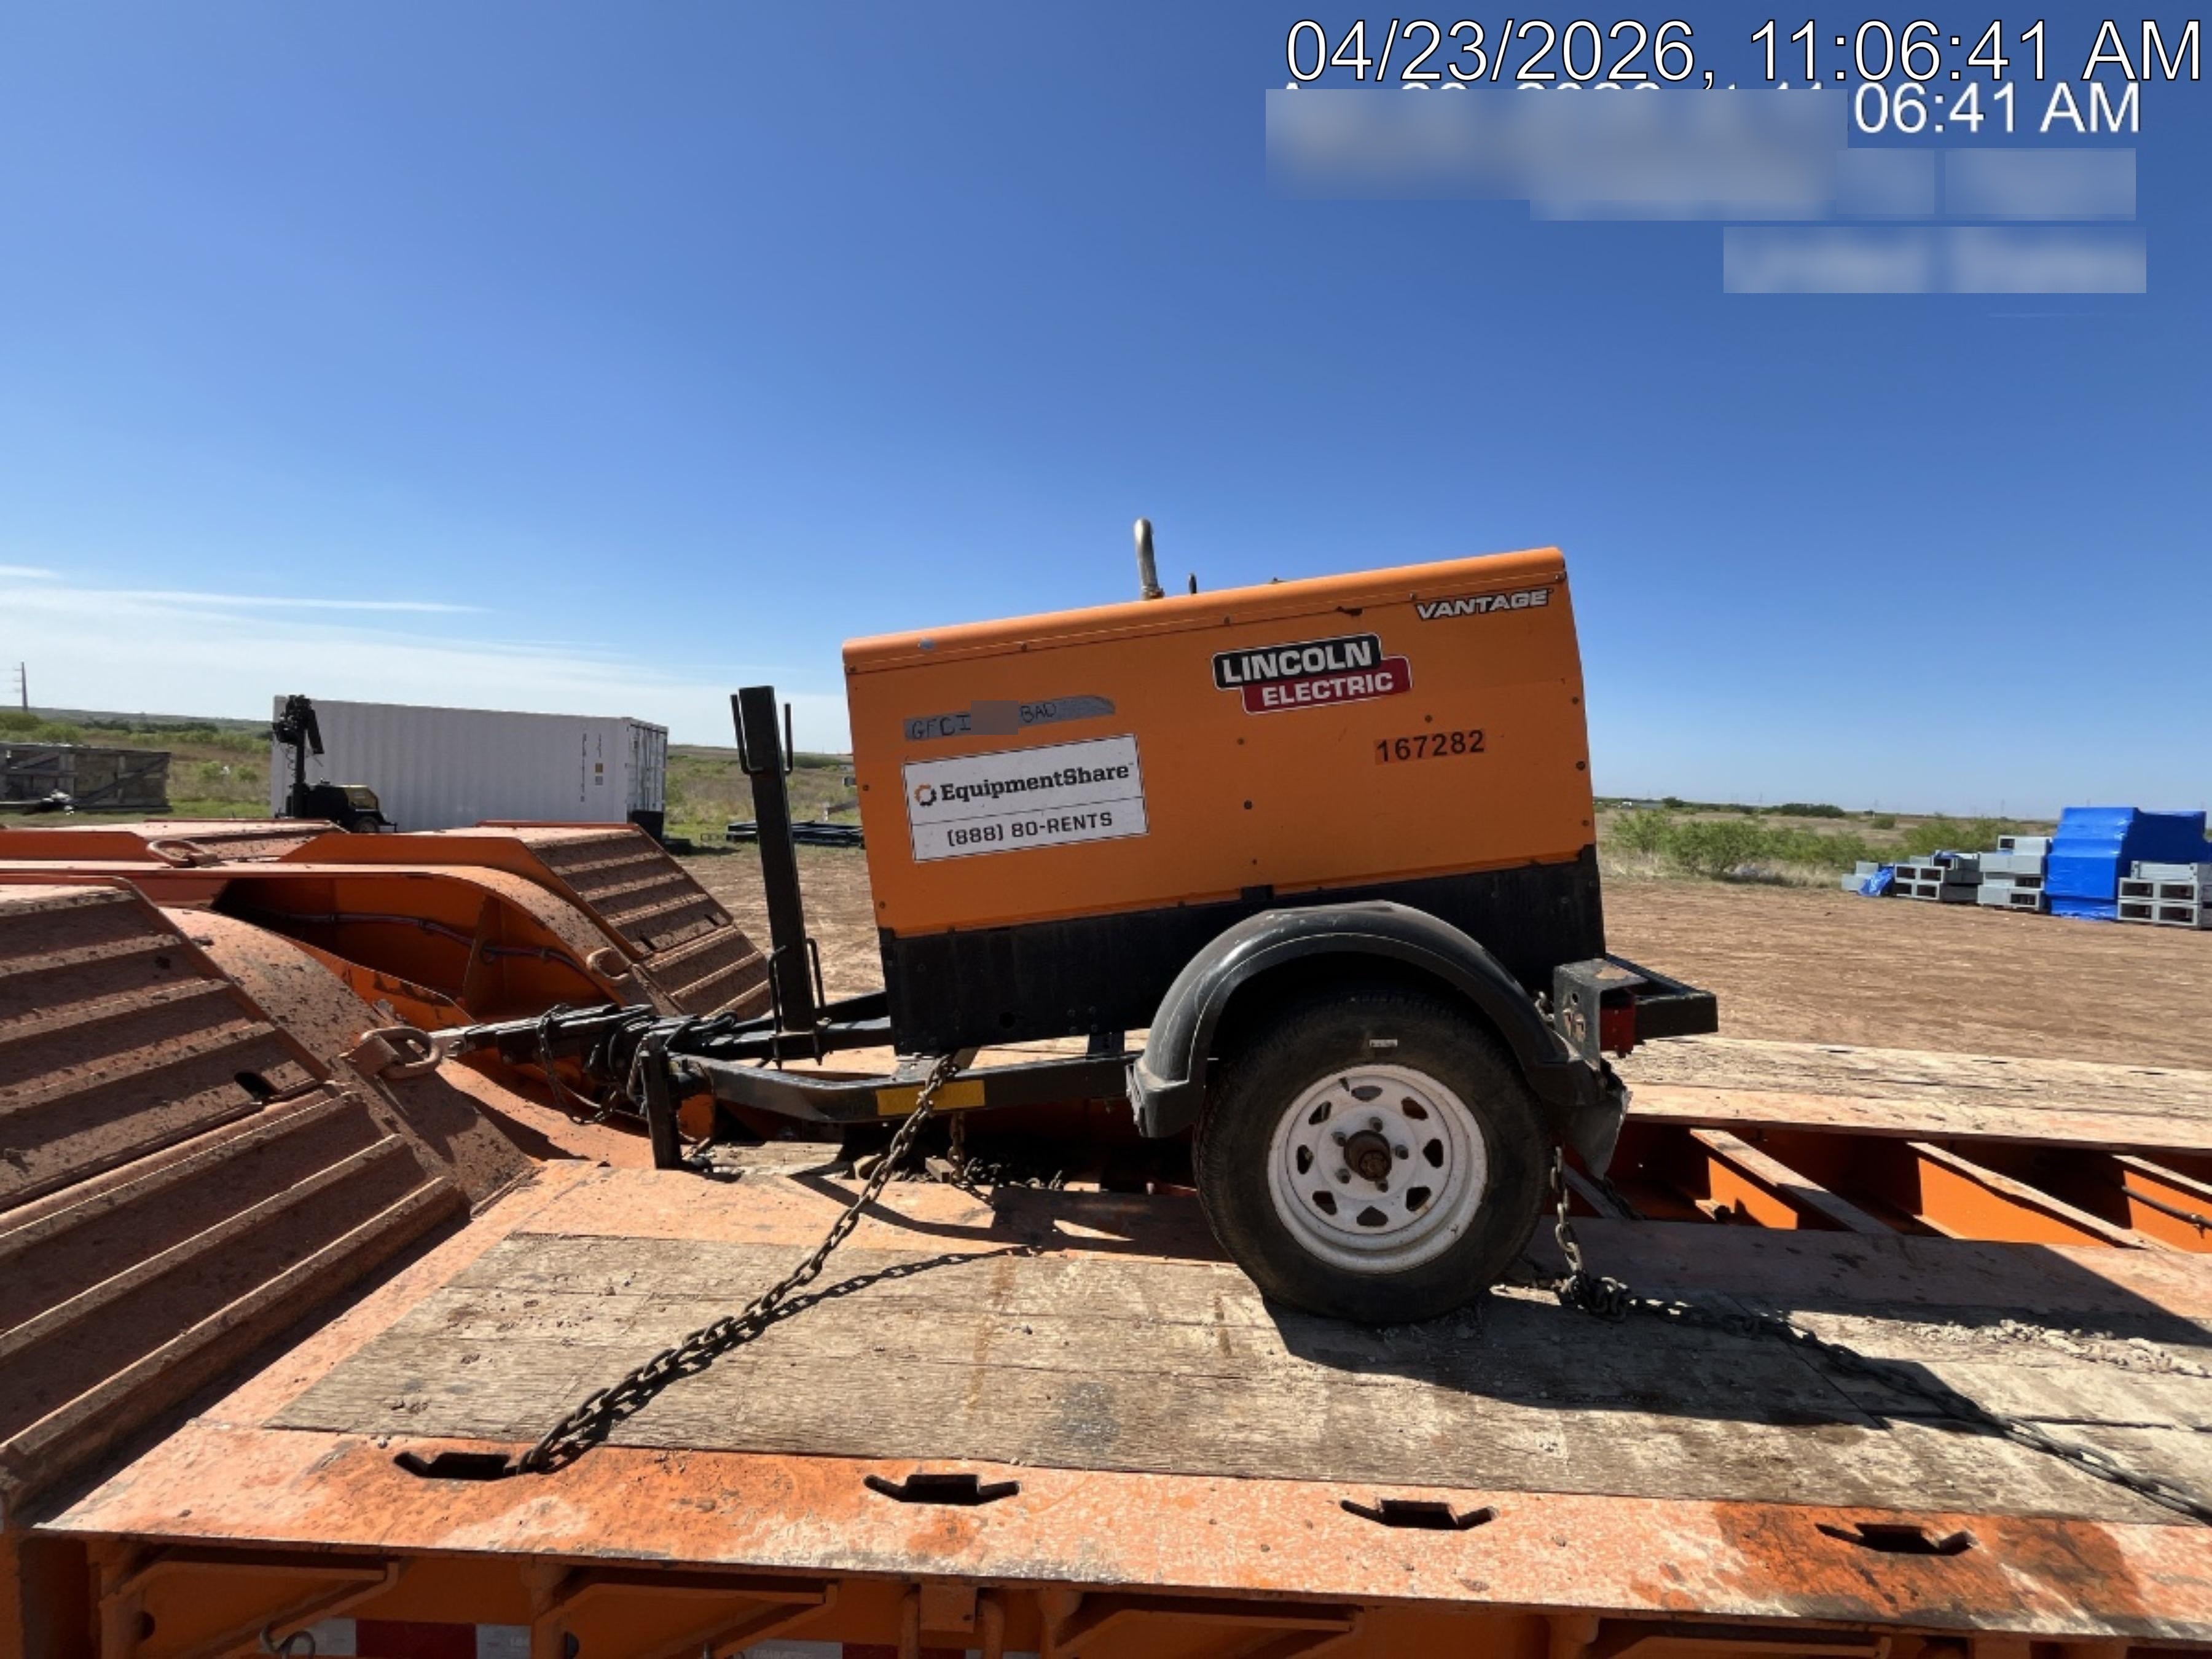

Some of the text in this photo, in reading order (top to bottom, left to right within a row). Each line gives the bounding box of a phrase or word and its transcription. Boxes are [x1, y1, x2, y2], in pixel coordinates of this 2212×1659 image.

[1416, 588, 1549, 621] VANTAGE
[1222, 641, 1373, 683] LINCOLN
[1262, 672, 1394, 707] ELECTRIC
[911, 715, 971, 739] GFCI
[1376, 729, 1485, 762] 167282
[939, 764, 1131, 801] EquipmentShare
[947, 811, 1113, 847] (888) 80-RENTS
